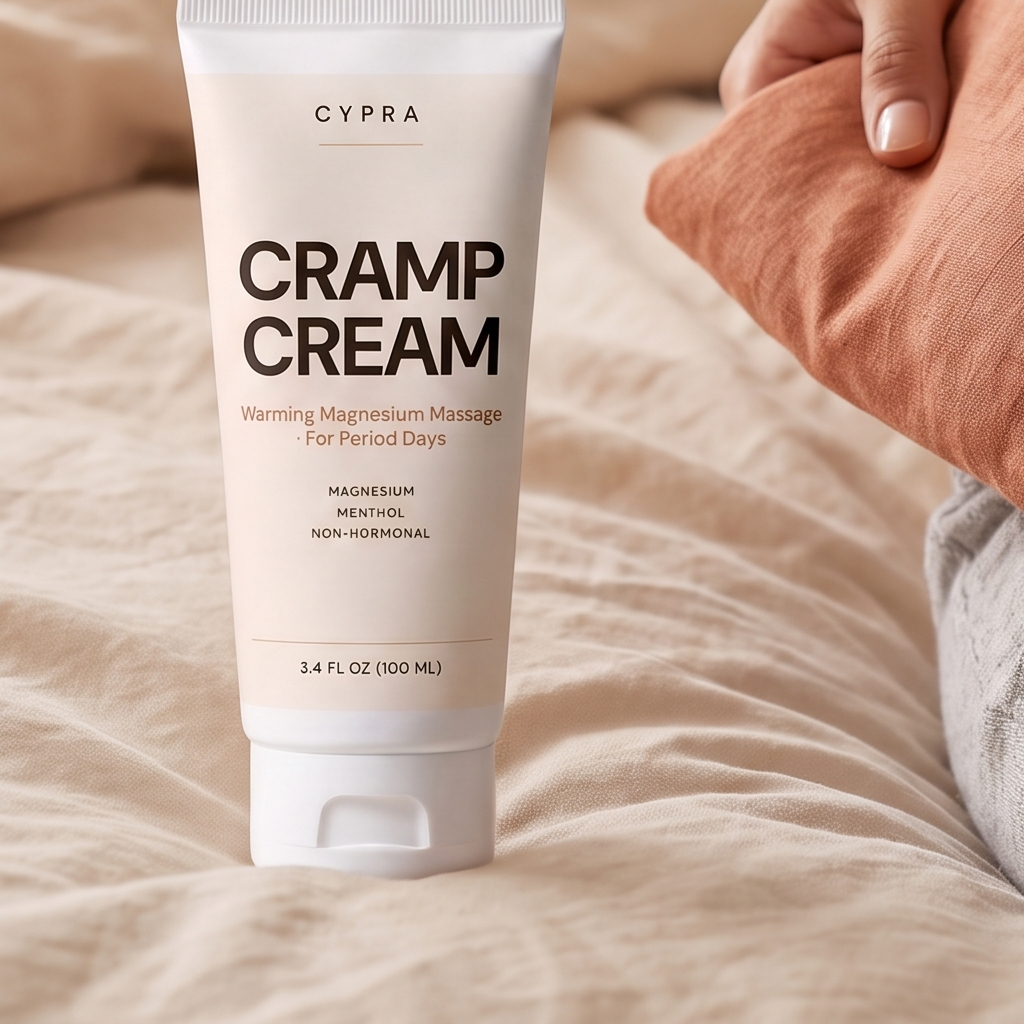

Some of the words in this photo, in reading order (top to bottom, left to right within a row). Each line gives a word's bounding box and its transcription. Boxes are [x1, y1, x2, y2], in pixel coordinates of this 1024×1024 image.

[314, 104, 420, 123] CYPRA
[239, 240, 505, 301] CRAMP
[243, 316, 500, 377] CREAM
[240, 405, 315, 427] Warming
[320, 405, 424, 427] Magnesium
[429, 405, 503, 427] Massage
[305, 430, 334, 446] For
[339, 429, 397, 446] Period
[402, 430, 447, 450] Days
[328, 485, 415, 498] MAGNESIUM
[336, 507, 405, 519] MENTHOL
[311, 527, 430, 539] NON-HORMONAL
[299, 660, 323, 676] 3.4
[328, 660, 344, 676] FL
[349, 660, 371, 676] OZ
[376, 659, 409, 678] (100
[415, 659, 442, 678] ML)
